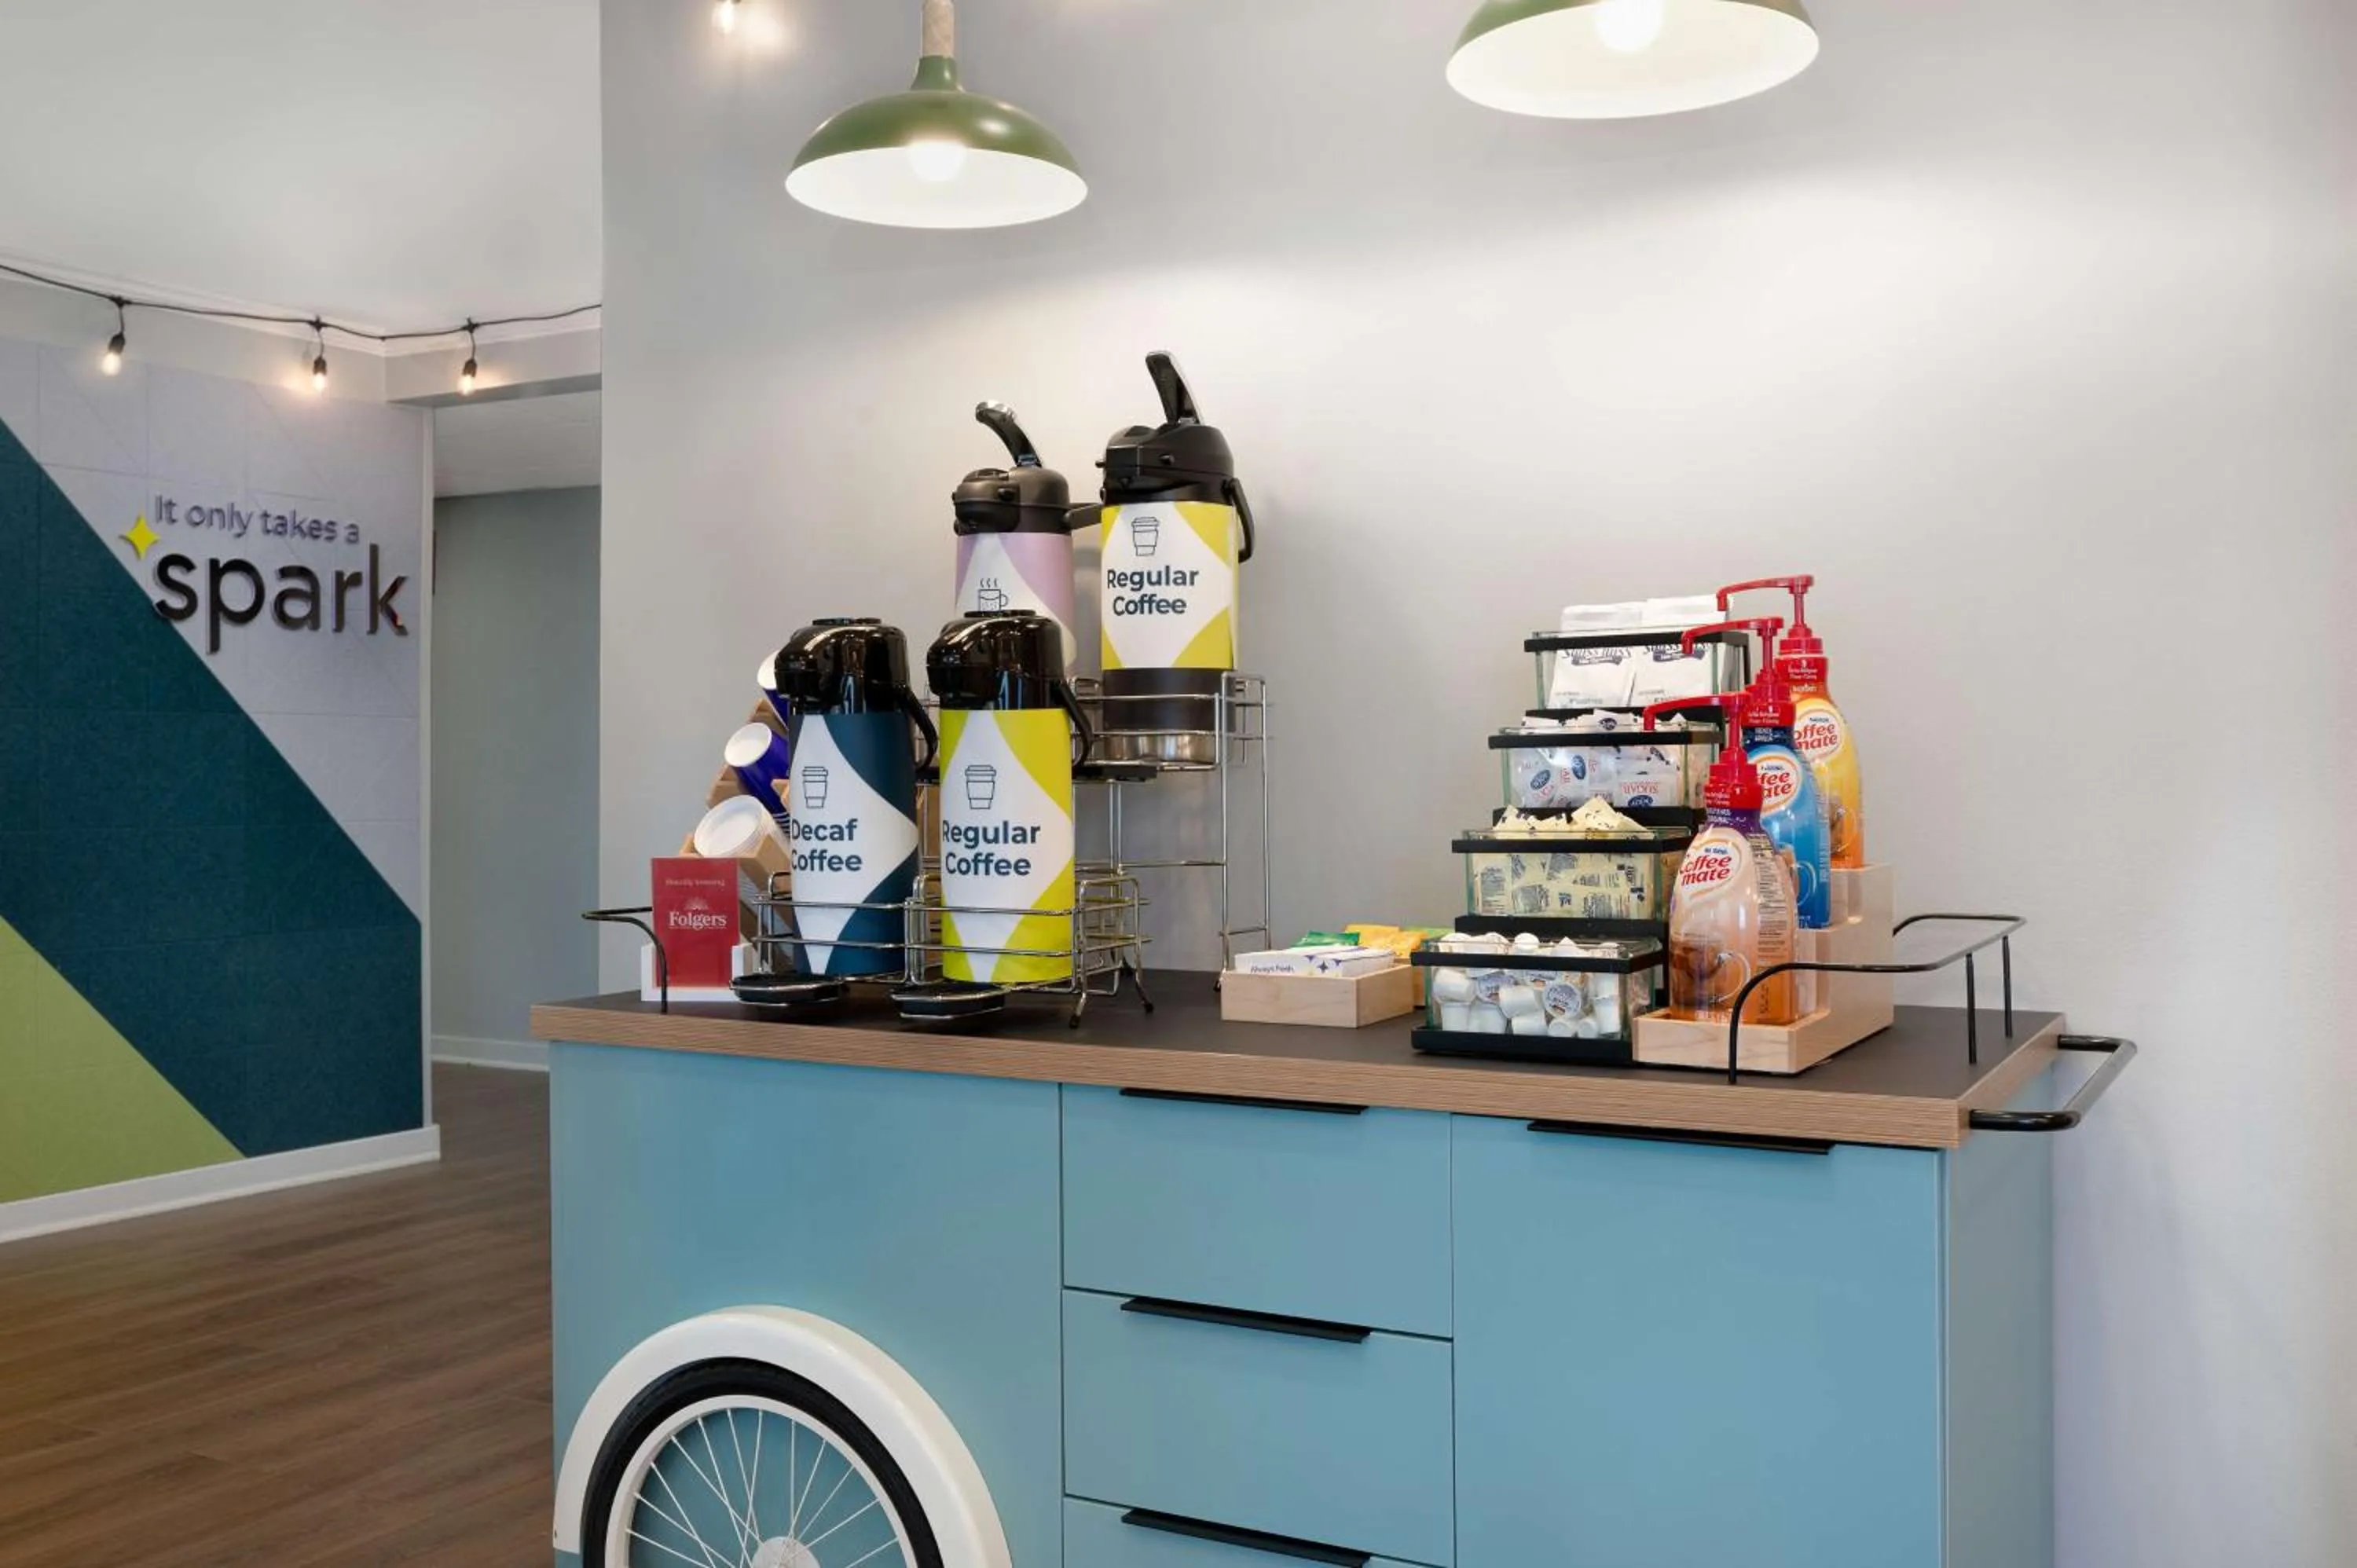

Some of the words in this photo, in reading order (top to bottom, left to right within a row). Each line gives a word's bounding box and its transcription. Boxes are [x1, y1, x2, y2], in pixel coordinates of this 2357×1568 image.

[156, 495, 178, 526] It
[185, 502, 254, 539] only
[259, 508, 338, 543] takes
[344, 522, 360, 545] a
[1107, 565, 1200, 592] Regular
[154, 543, 409, 655] spark
[1113, 594, 1187, 617] Coffee
[1794, 723, 1835, 741] offee
[791, 818, 859, 841] Decaf
[942, 819, 1041, 849] Regular
[945, 852, 1032, 876] Coffee
[1681, 866, 1731, 886] mate
[669, 911, 728, 931] Folgers
